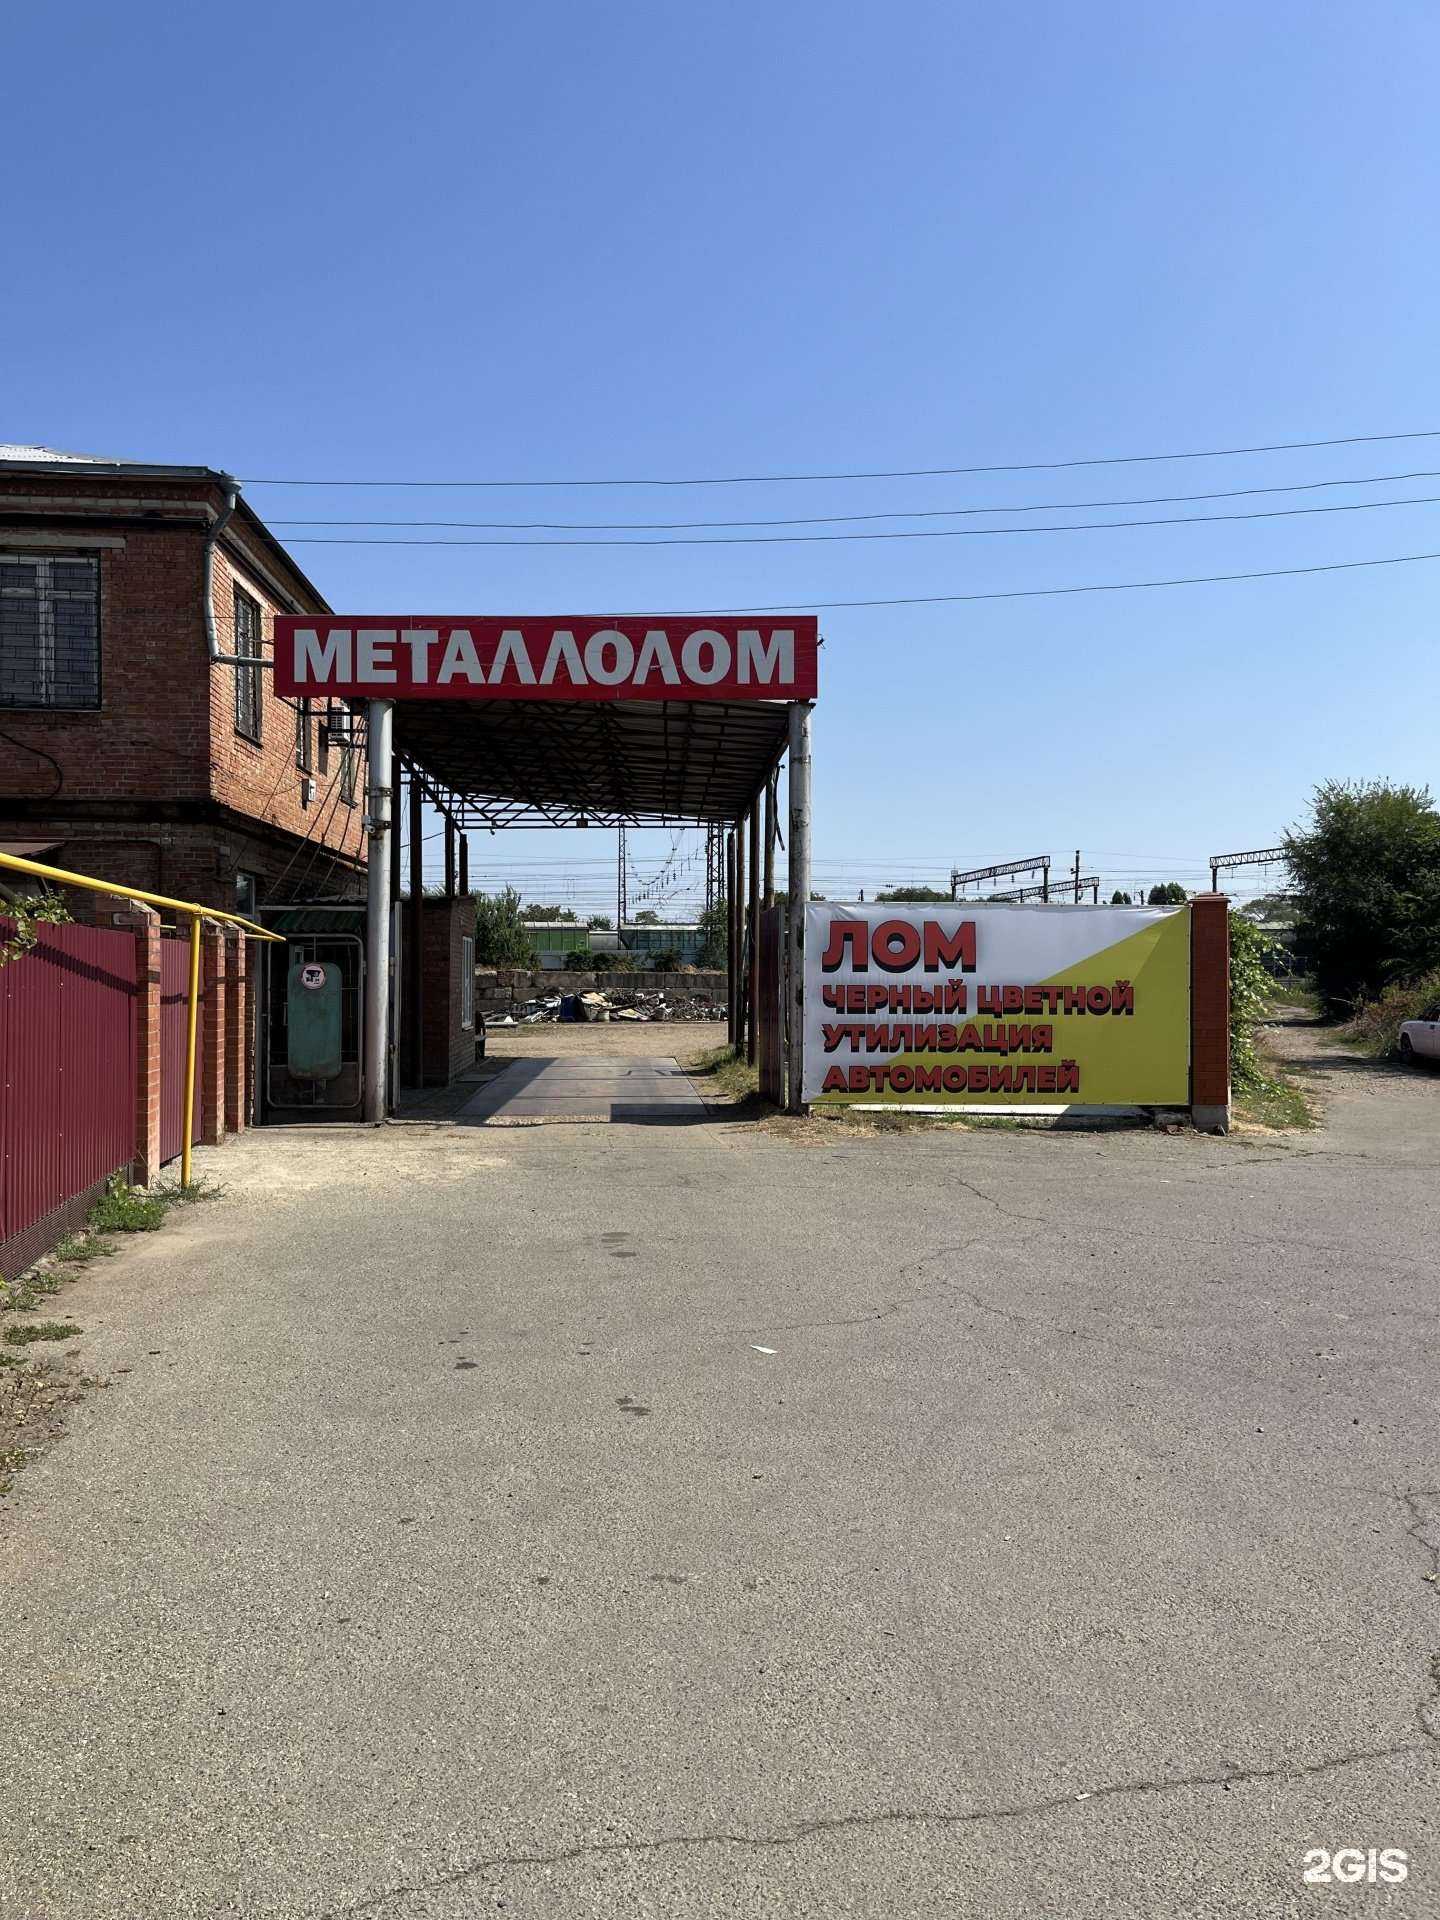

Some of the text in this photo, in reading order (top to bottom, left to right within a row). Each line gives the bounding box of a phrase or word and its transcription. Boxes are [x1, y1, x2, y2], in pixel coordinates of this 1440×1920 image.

[293, 629, 795, 686] МЕТАЛЛОЛОМ
[821, 919, 977, 973] ЛОМ
[822, 979, 1135, 1018] ЧЕРНЫЙ ЦВЕТНОЙ
[822, 1023, 1053, 1056] УТИЛИЗАЦИЯ
[821, 1060, 1080, 1094] АВТОМОБИЛЕЙ
